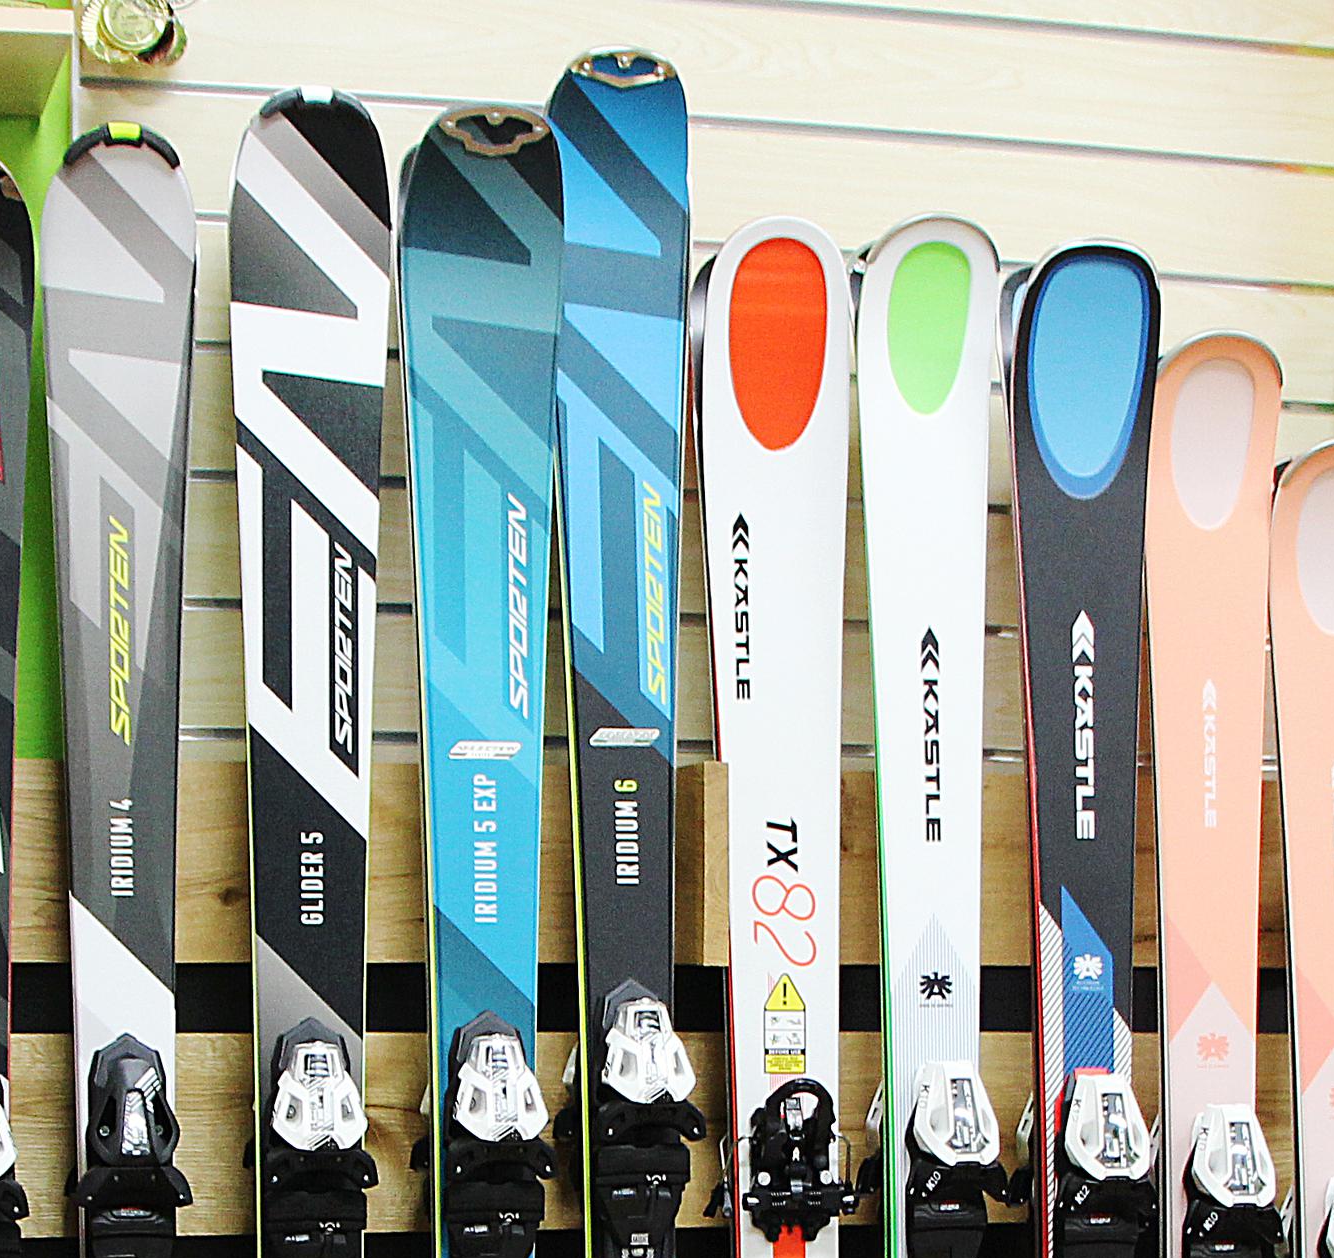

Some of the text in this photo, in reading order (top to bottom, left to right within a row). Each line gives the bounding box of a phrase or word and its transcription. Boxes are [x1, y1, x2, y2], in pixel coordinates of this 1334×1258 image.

[108, 515, 131, 744] SPORTEN
[507, 494, 528, 718] SPORTEN
[642, 482, 666, 705] SPORTEN
[332, 543, 354, 754] SPORTEN
[474, 775, 496, 811] EXP
[474, 819, 495, 835] 5
[615, 780, 640, 886] IRIDIUM 6
[110, 798, 134, 897] IRIDIUM 4
[301, 831, 324, 926] GLIDER 5
[474, 845, 497, 923] IRIDIUM
